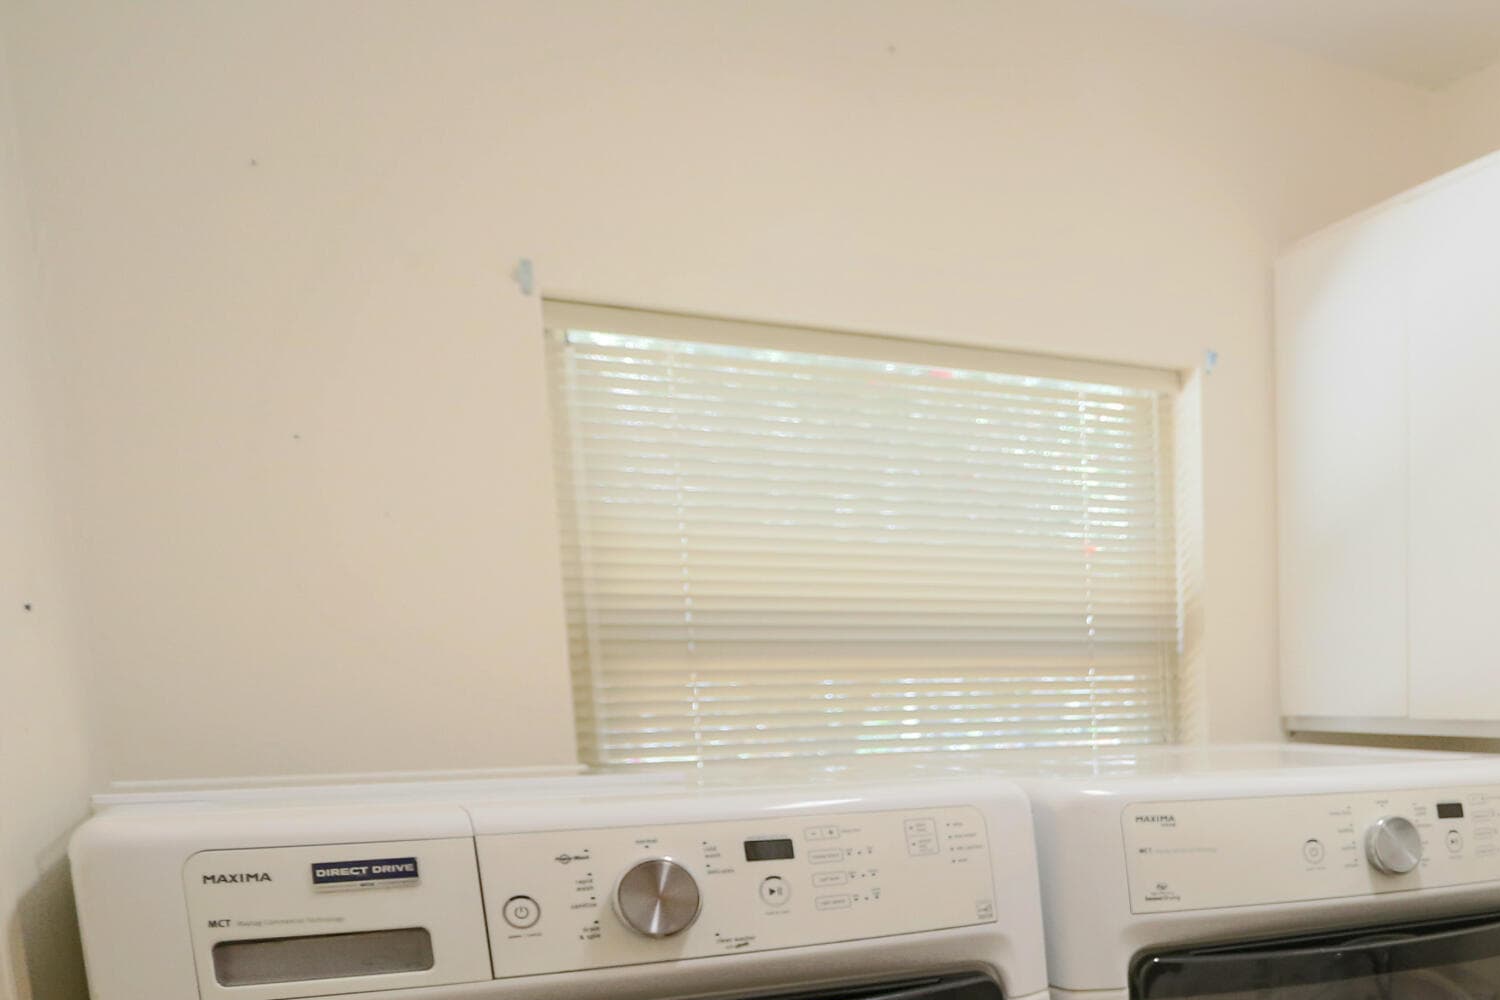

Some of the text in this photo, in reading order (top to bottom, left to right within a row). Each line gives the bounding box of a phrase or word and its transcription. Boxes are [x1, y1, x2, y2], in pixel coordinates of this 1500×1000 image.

[1134, 815, 1175, 823] MAXIMA
[315, 863, 416, 879] DIRECT DRIVE
[202, 872, 273, 885] MAXIMA
[207, 919, 232, 928] MCT
